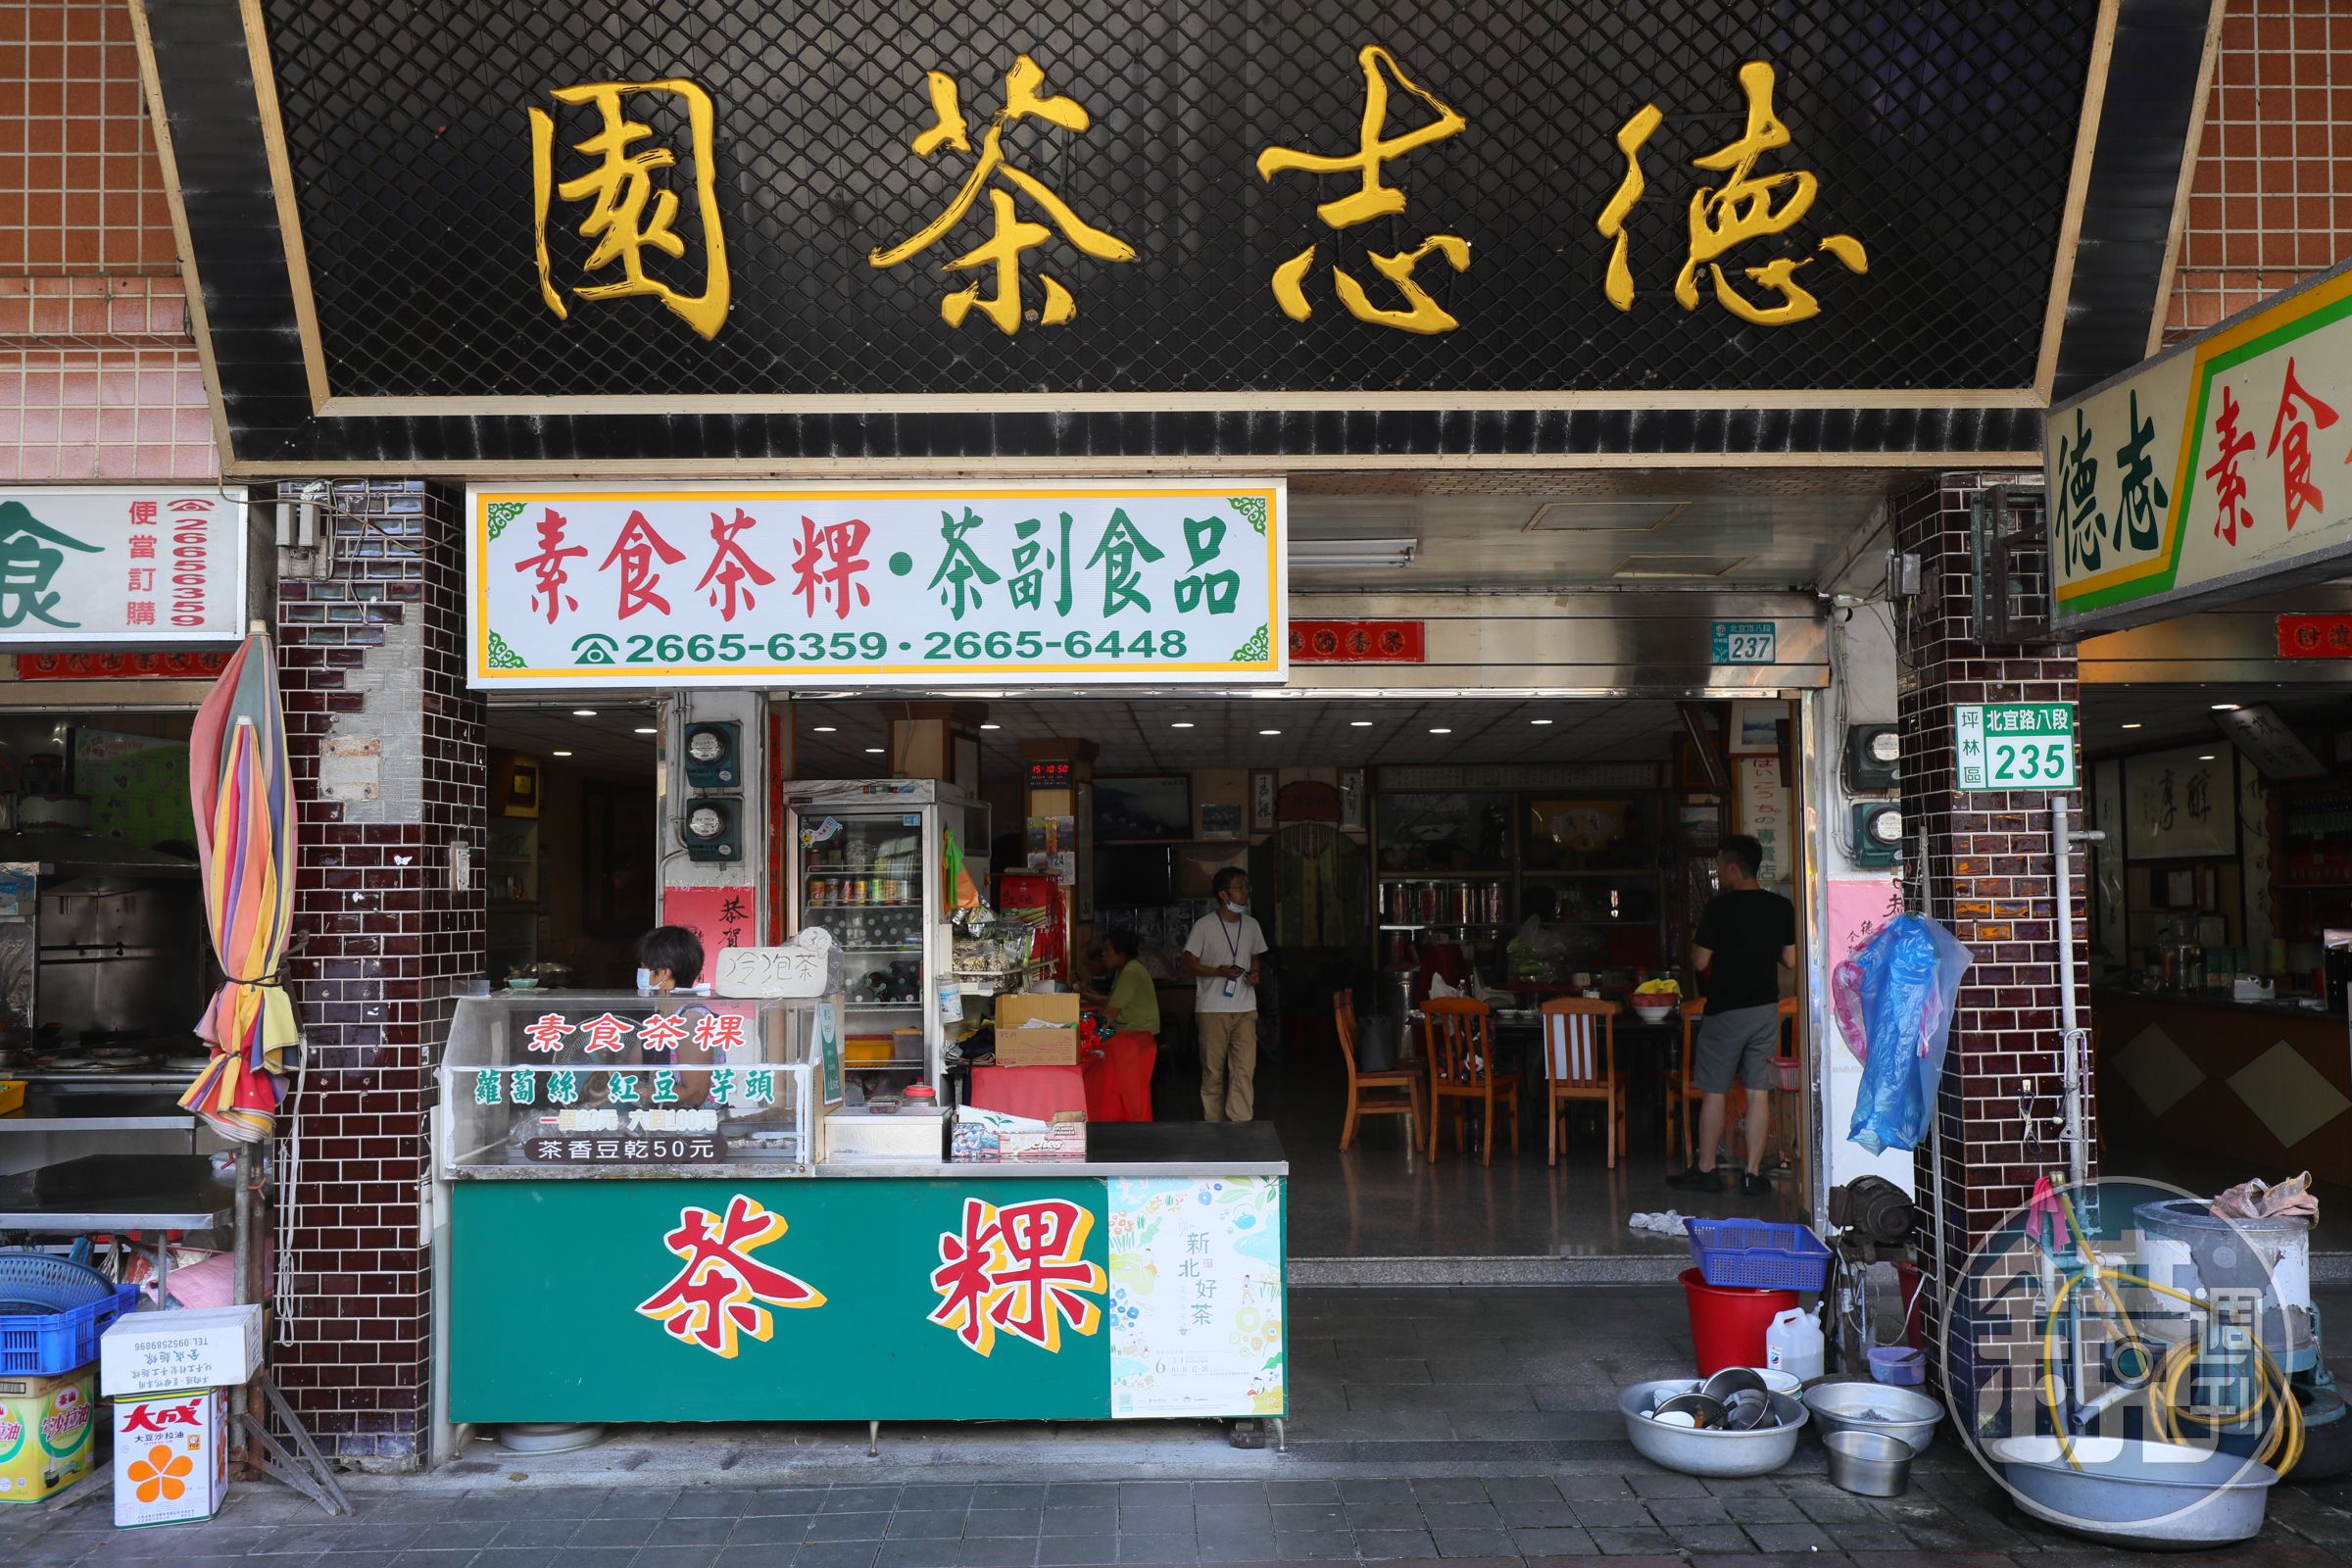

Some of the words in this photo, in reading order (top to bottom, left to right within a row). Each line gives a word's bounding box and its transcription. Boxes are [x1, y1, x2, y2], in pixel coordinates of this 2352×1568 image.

[2205, 356, 2352, 547] 素食
[2055, 389, 2169, 579] 德志
[126, 500, 158, 627] 便當訂購
[171, 518, 207, 627] 26656359
[1732, 637, 1771, 659] 237
[1986, 709, 2069, 732] 北宜路八段
[1961, 710, 1982, 784] 坪林區
[1994, 744, 2065, 779] 235
[725, 952, 819, 985] 冷泡茶
[523, 1012, 746, 1054] 素食茶粿
[474, 1069, 578, 1104] 蘿蔔絲
[607, 1071, 679, 1102] 紅豆
[709, 1069, 775, 1105] 芋頭
[538, 1139, 714, 1159] 茶香豆乾50元
[1178, 1232, 1217, 1325] 新北好茶
[119, 1398, 204, 1433] 大成
[134, 1431, 184, 1443] 大豆沙拉油
